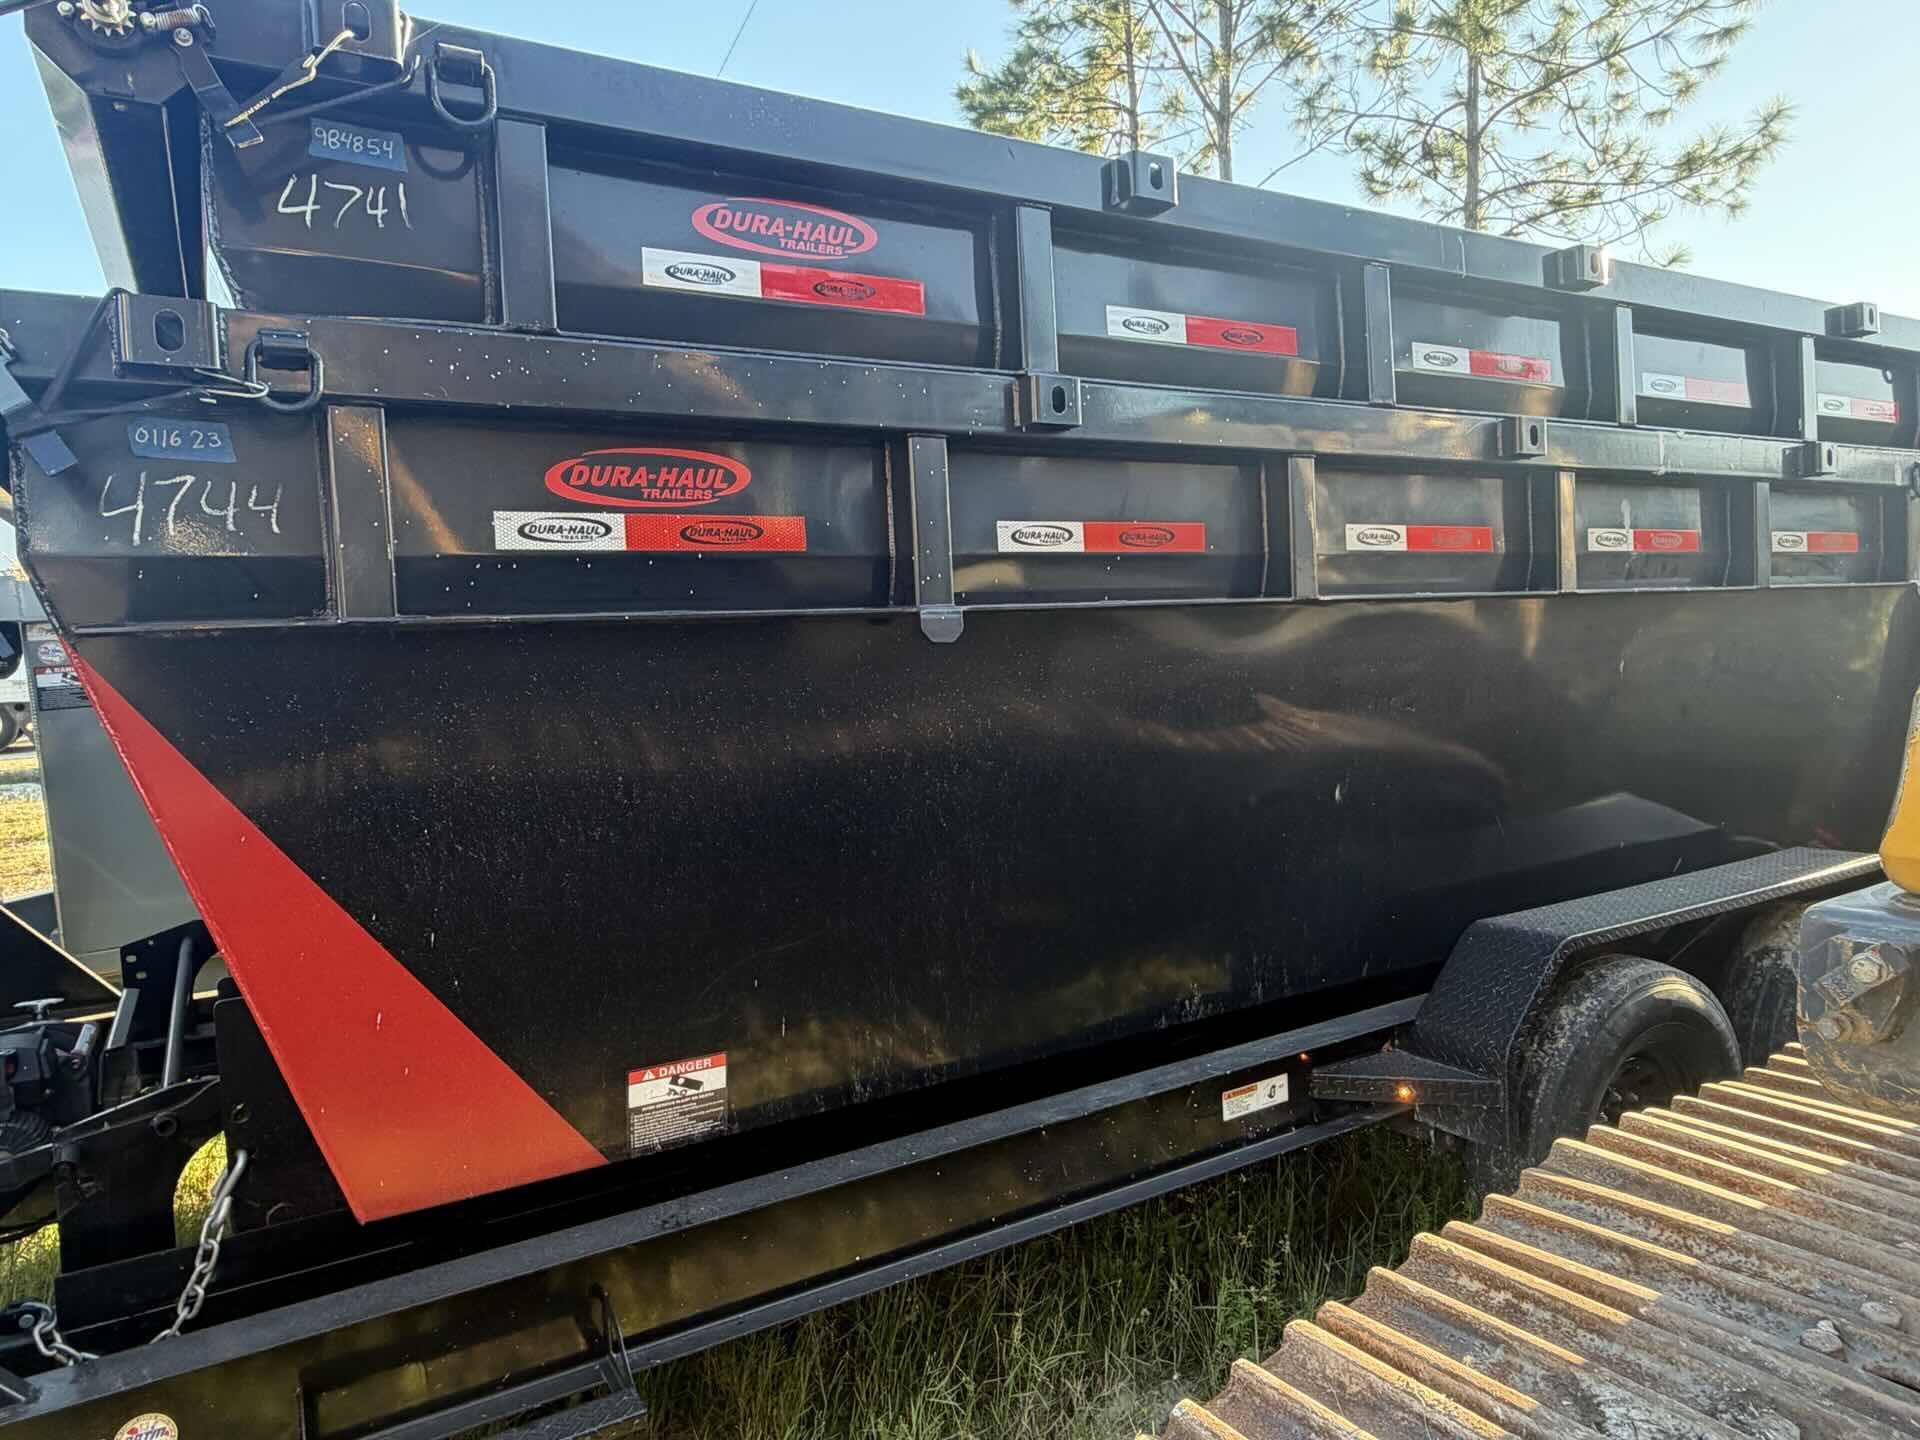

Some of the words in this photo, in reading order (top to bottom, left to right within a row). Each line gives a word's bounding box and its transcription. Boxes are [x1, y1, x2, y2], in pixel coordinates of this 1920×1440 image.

[314, 127, 394, 160] 984854
[277, 174, 413, 229] 4741
[713, 208, 858, 247] DURA-HAUL
[779, 238, 843, 256] TRAILERS
[672, 266, 728, 281] DURA-HAUL
[569, 465, 729, 490] DURA-HAUL
[641, 488, 713, 500] TRAILERS
[100, 471, 283, 546] 4744
[527, 524, 602, 536] DURA-HAUL
[688, 526, 755, 538] DURA-HAUL
[1017, 531, 1067, 541] DURA-HAUL
[658, 1058, 712, 1078] DANGER
